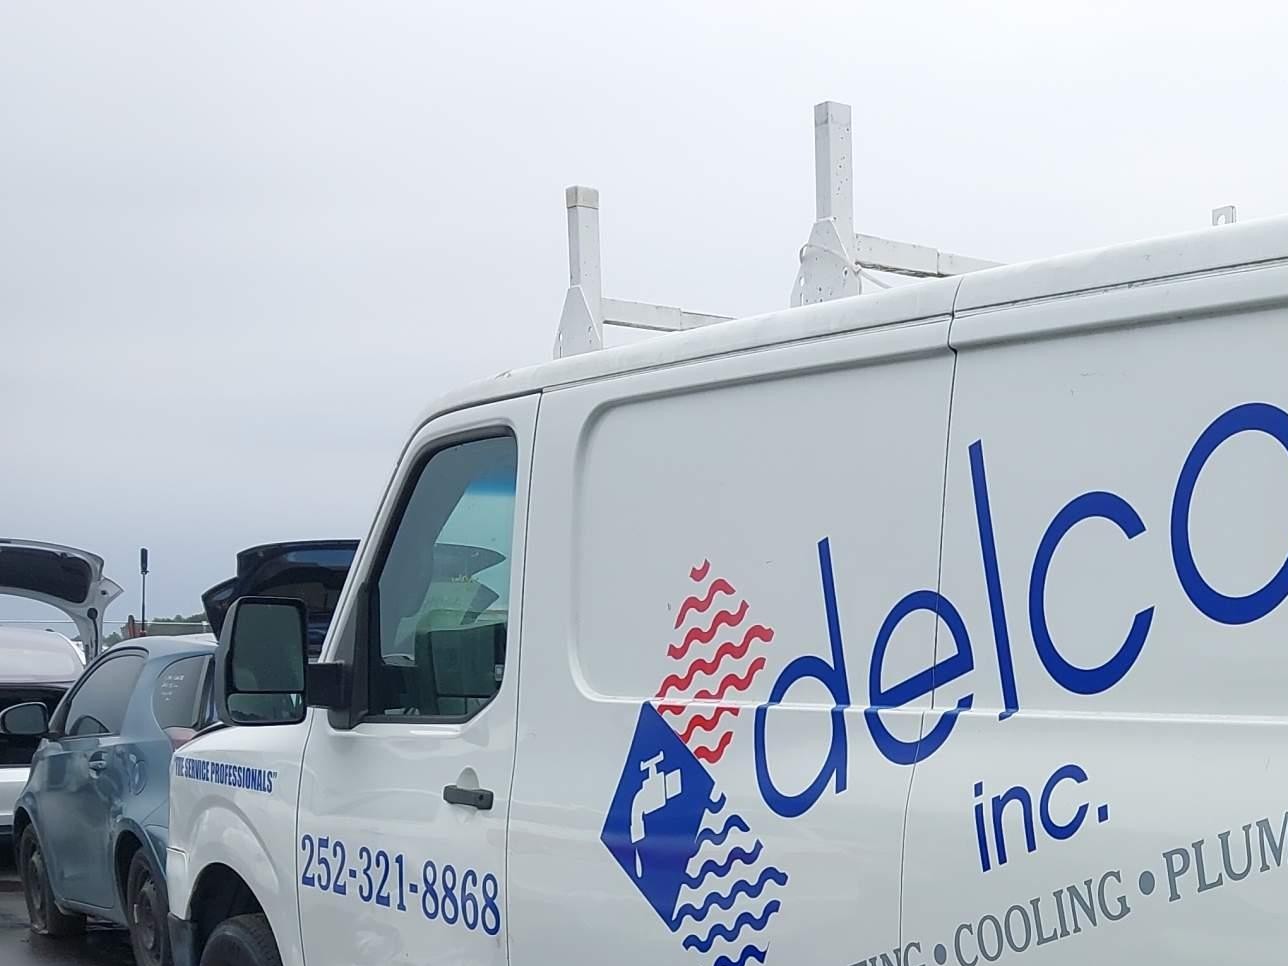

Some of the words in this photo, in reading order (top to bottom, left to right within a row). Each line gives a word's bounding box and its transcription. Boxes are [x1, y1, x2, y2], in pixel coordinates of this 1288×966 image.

[184, 758, 209, 781] SERVICE
[974, 764, 1110, 872] inc.
[302, 834, 500, 935] 252-321-8868
